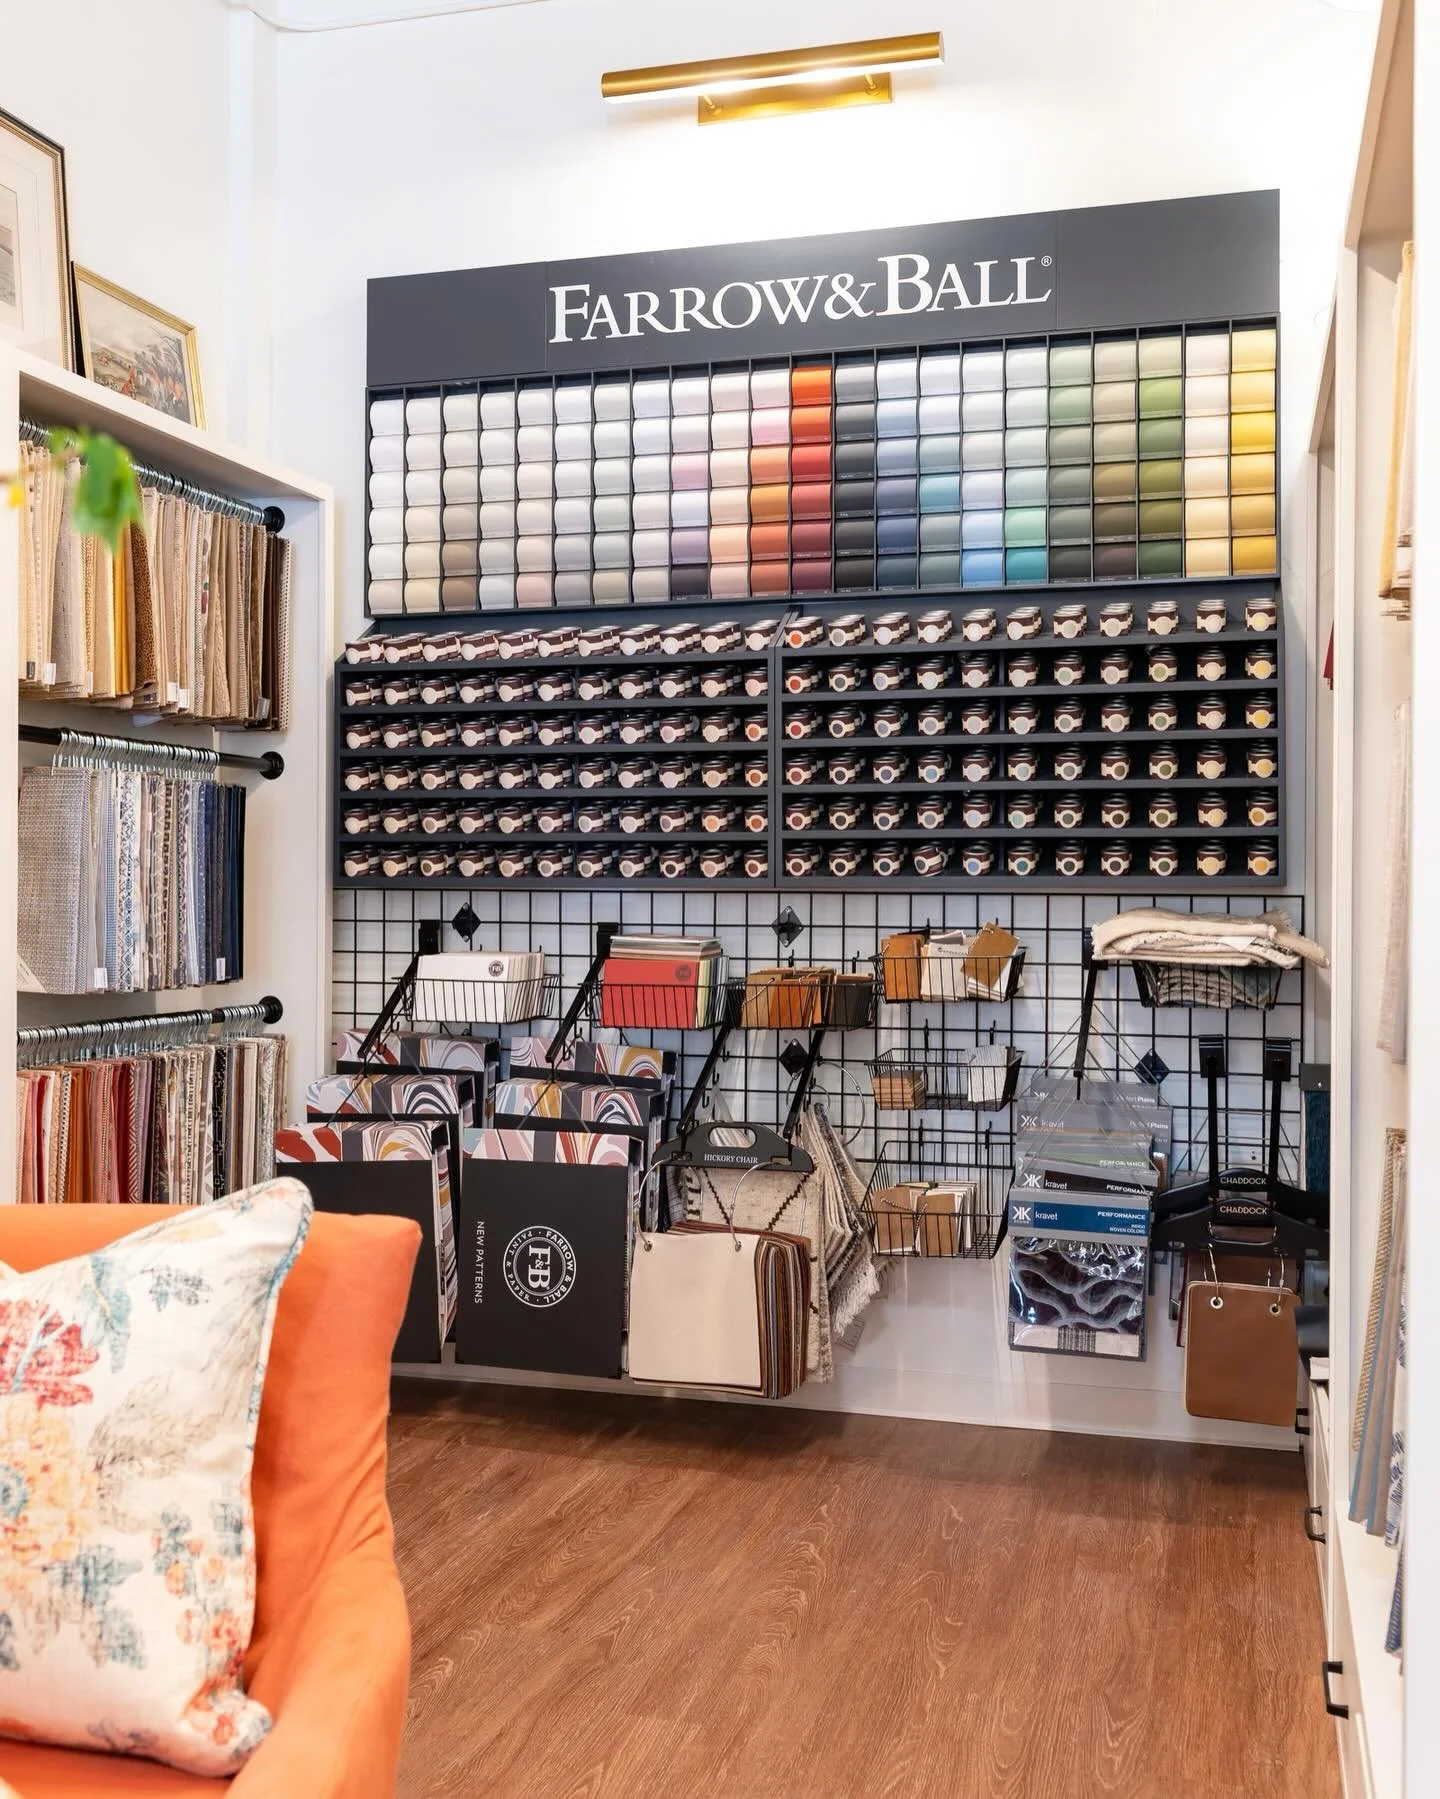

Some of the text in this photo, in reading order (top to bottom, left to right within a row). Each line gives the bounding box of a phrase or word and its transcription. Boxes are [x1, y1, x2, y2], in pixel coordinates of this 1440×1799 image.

[704, 1154, 758, 1164] HICKORY CHAIR
[1045, 1179, 1067, 1190] kravet
[1220, 1177, 1267, 1185] CHADDOCK
[1106, 1184, 1154, 1196] PERFORMANCE
[1097, 1211, 1146, 1220] PERFORMANCE
[1220, 1206, 1267, 1214] CHADDOCK
[1035, 1211, 1058, 1221] kravet
[508, 1230, 533, 1256] PAINT
[545, 1230, 575, 1272] FARROW
[474, 1221, 485, 1304] NEW PATTERNS
[507, 1273, 530, 1302] PAPER
[543, 1284, 568, 1304] BALL
